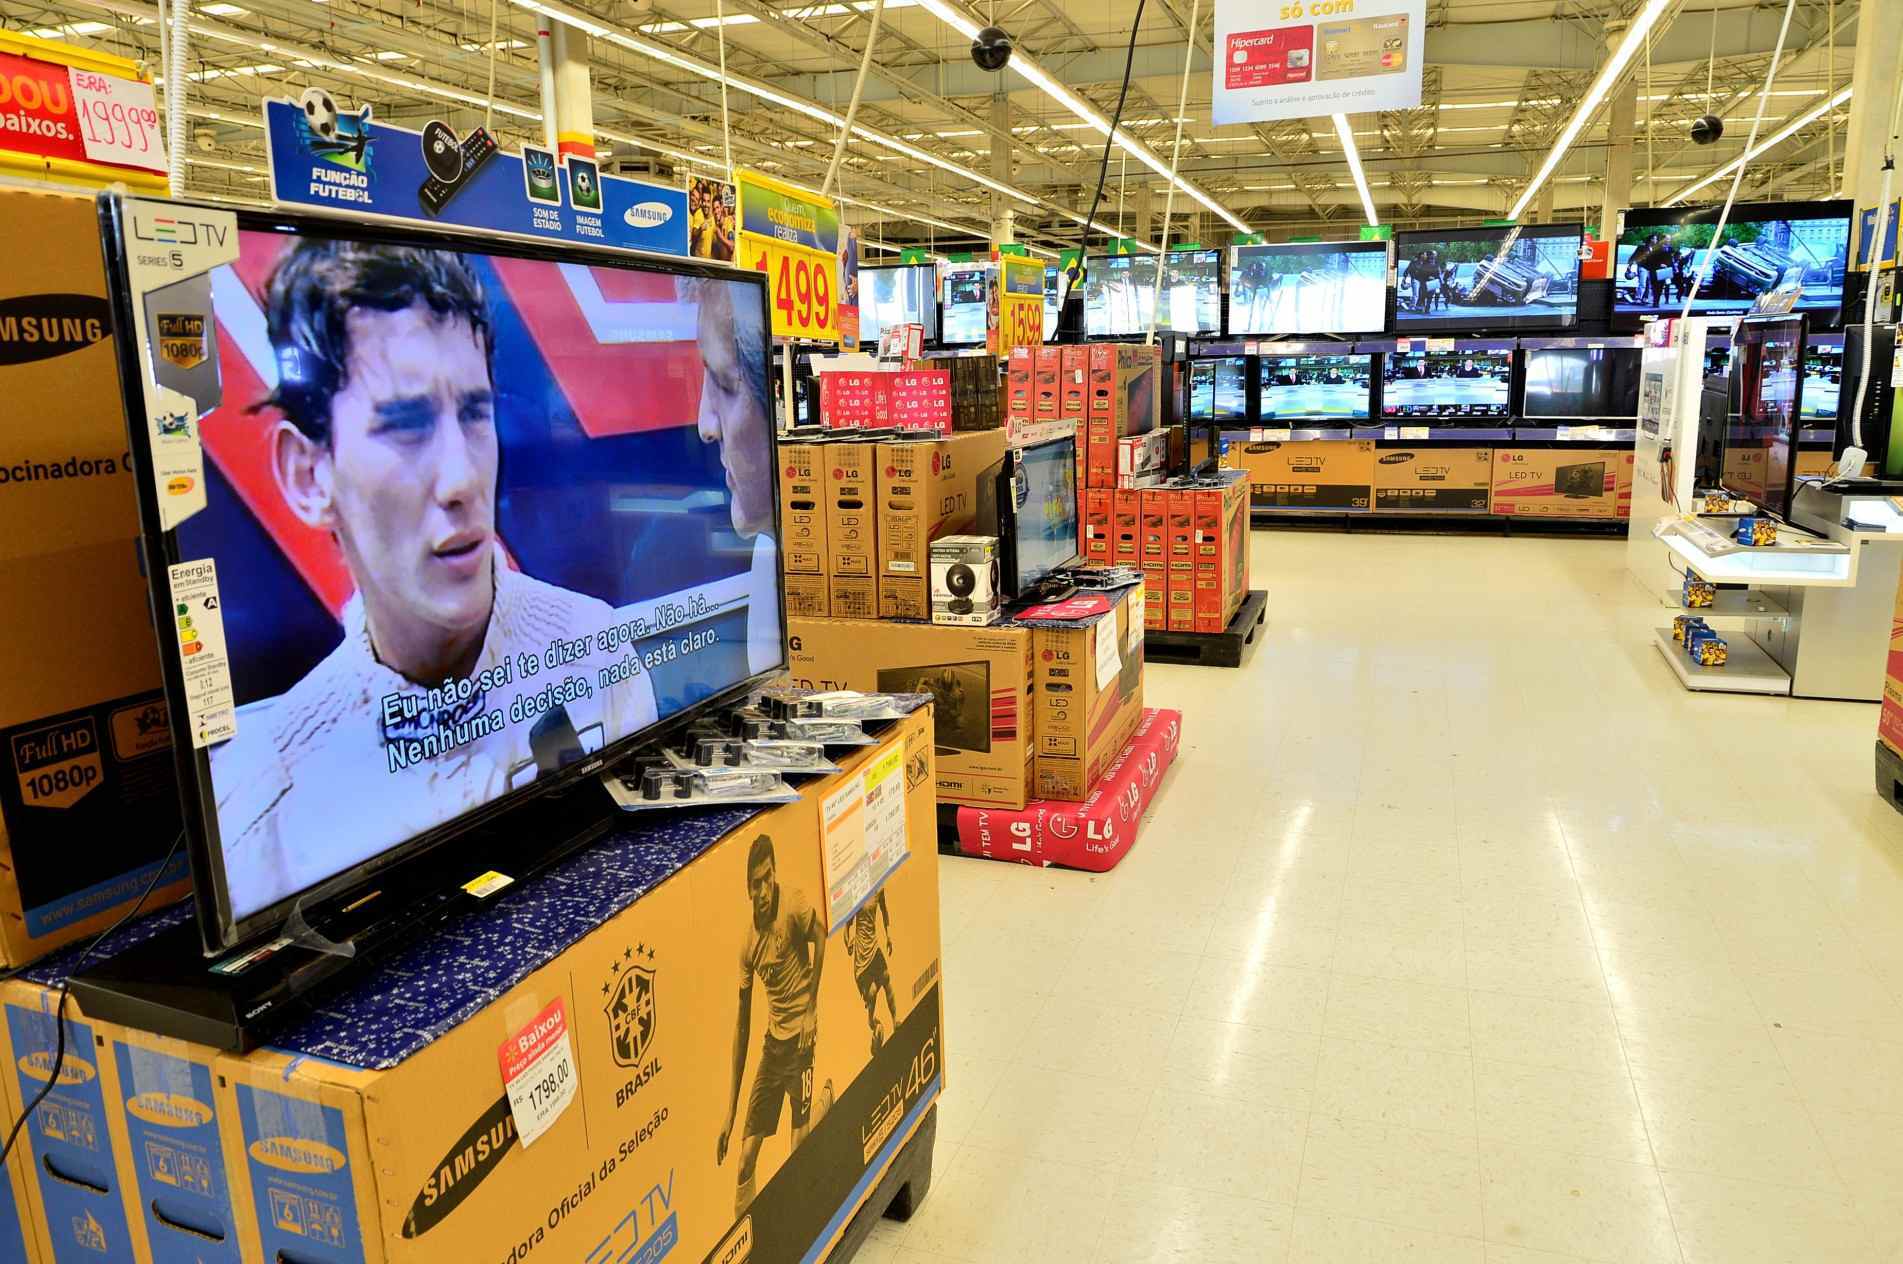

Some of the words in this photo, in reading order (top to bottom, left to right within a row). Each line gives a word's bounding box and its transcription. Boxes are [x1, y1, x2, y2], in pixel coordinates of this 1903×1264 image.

[1279, 4, 1304, 21] só
[1310, 0, 1354, 16] com
[1231, 33, 1274, 50] Hipercard
[76, 73, 112, 95] ERA:
[0, 110, 75, 141] aixos.
[311, 167, 368, 188] FUNÇÃO
[533, 207, 548, 219] SOM
[549, 210, 560, 221] DE
[533, 217, 562, 232] ESTÁDIO
[576, 215, 602, 227] IMAGEM
[630, 207, 669, 222] SAMSUNG
[134, 216, 198, 245] LED
[199, 223, 228, 247] TV
[576, 225, 605, 238] FUTEBOL
[137, 255, 168, 267] SERIES
[171, 251, 184, 268] 5
[185, 319, 202, 333] HD
[933, 377, 944, 385] LG
[849, 399, 860, 407] LG
[907, 400, 918, 408] LG
[934, 399, 945, 407] LG
[934, 421, 946, 429] LG
[799, 469, 811, 477] LG
[941, 454, 951, 471] LG
[845, 470, 858, 478] LG
[897, 469, 912, 478] LG
[1509, 471, 1527, 480] LED
[1530, 472, 1543, 480] TV
[956, 490, 968, 512] TV
[171, 564, 213, 580] Energia
[207, 598, 218, 608] A
[381, 692, 419, 728] Eu
[426, 677, 473, 712] não
[479, 656, 513, 693] sei
[518, 651, 539, 679] te
[544, 635, 593, 669] dizer
[597, 618, 651, 652] agora.
[654, 603, 685, 630] Não
[687, 593, 721, 619] há...
[1056, 651, 1070, 660] LG
[386, 707, 506, 773] Nenhuma
[510, 674, 593, 724] decisão,
[598, 654, 641, 689] nada
[644, 639, 677, 669] está
[680, 627, 721, 655] claro.
[20, 731, 59, 765] Full
[62, 729, 91, 749] HD
[1147, 751, 1158, 777] LG
[26, 764, 97, 800] 1080p
[1127, 781, 1140, 809] LG
[1010, 821, 1032, 852] LG
[1087, 816, 1113, 841] LG
[245, 1000, 273, 1019] SONY
[624, 1004, 642, 1026] CBF
[518, 1009, 561, 1053] Baixou
[529, 1058, 569, 1111] 1798,00
[615, 1057, 663, 1110] BRASIL
[801, 1067, 813, 1100] 18
[891, 1076, 903, 1105] TV
[137, 1097, 204, 1126] SAMSUNG
[260, 1140, 337, 1172] SAMSUNG
[547, 1172, 597, 1230] Oficial
[598, 1157, 617, 1182] da
[618, 1106, 670, 1163] Seleção
[640, 1167, 674, 1226] TV
